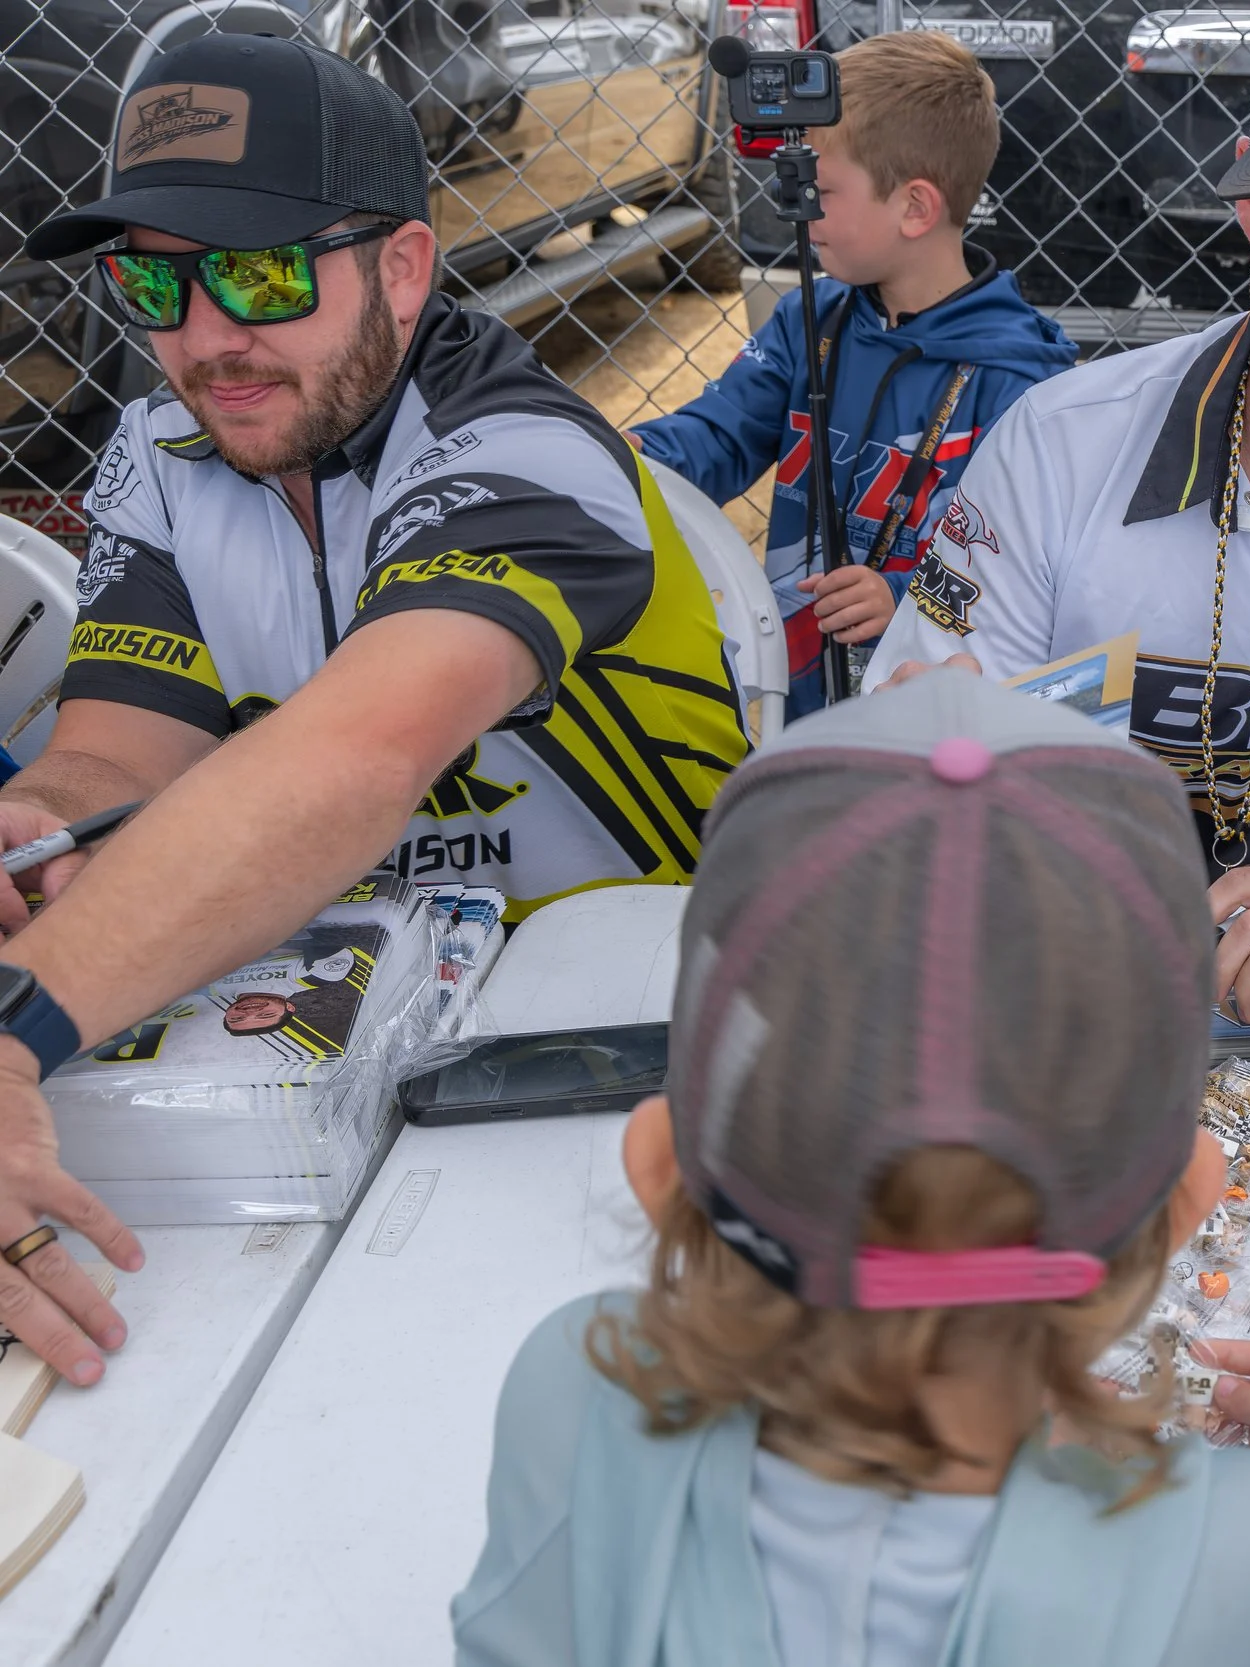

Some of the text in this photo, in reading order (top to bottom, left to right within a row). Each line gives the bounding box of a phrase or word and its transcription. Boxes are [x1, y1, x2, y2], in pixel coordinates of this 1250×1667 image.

[905, 25, 1048, 44] EDITION
[152, 113, 219, 131] MADISON
[936, 403, 952, 424] PRIX
[376, 829, 512, 881] ISON
[380, 1180, 434, 1249] LIFETIME
